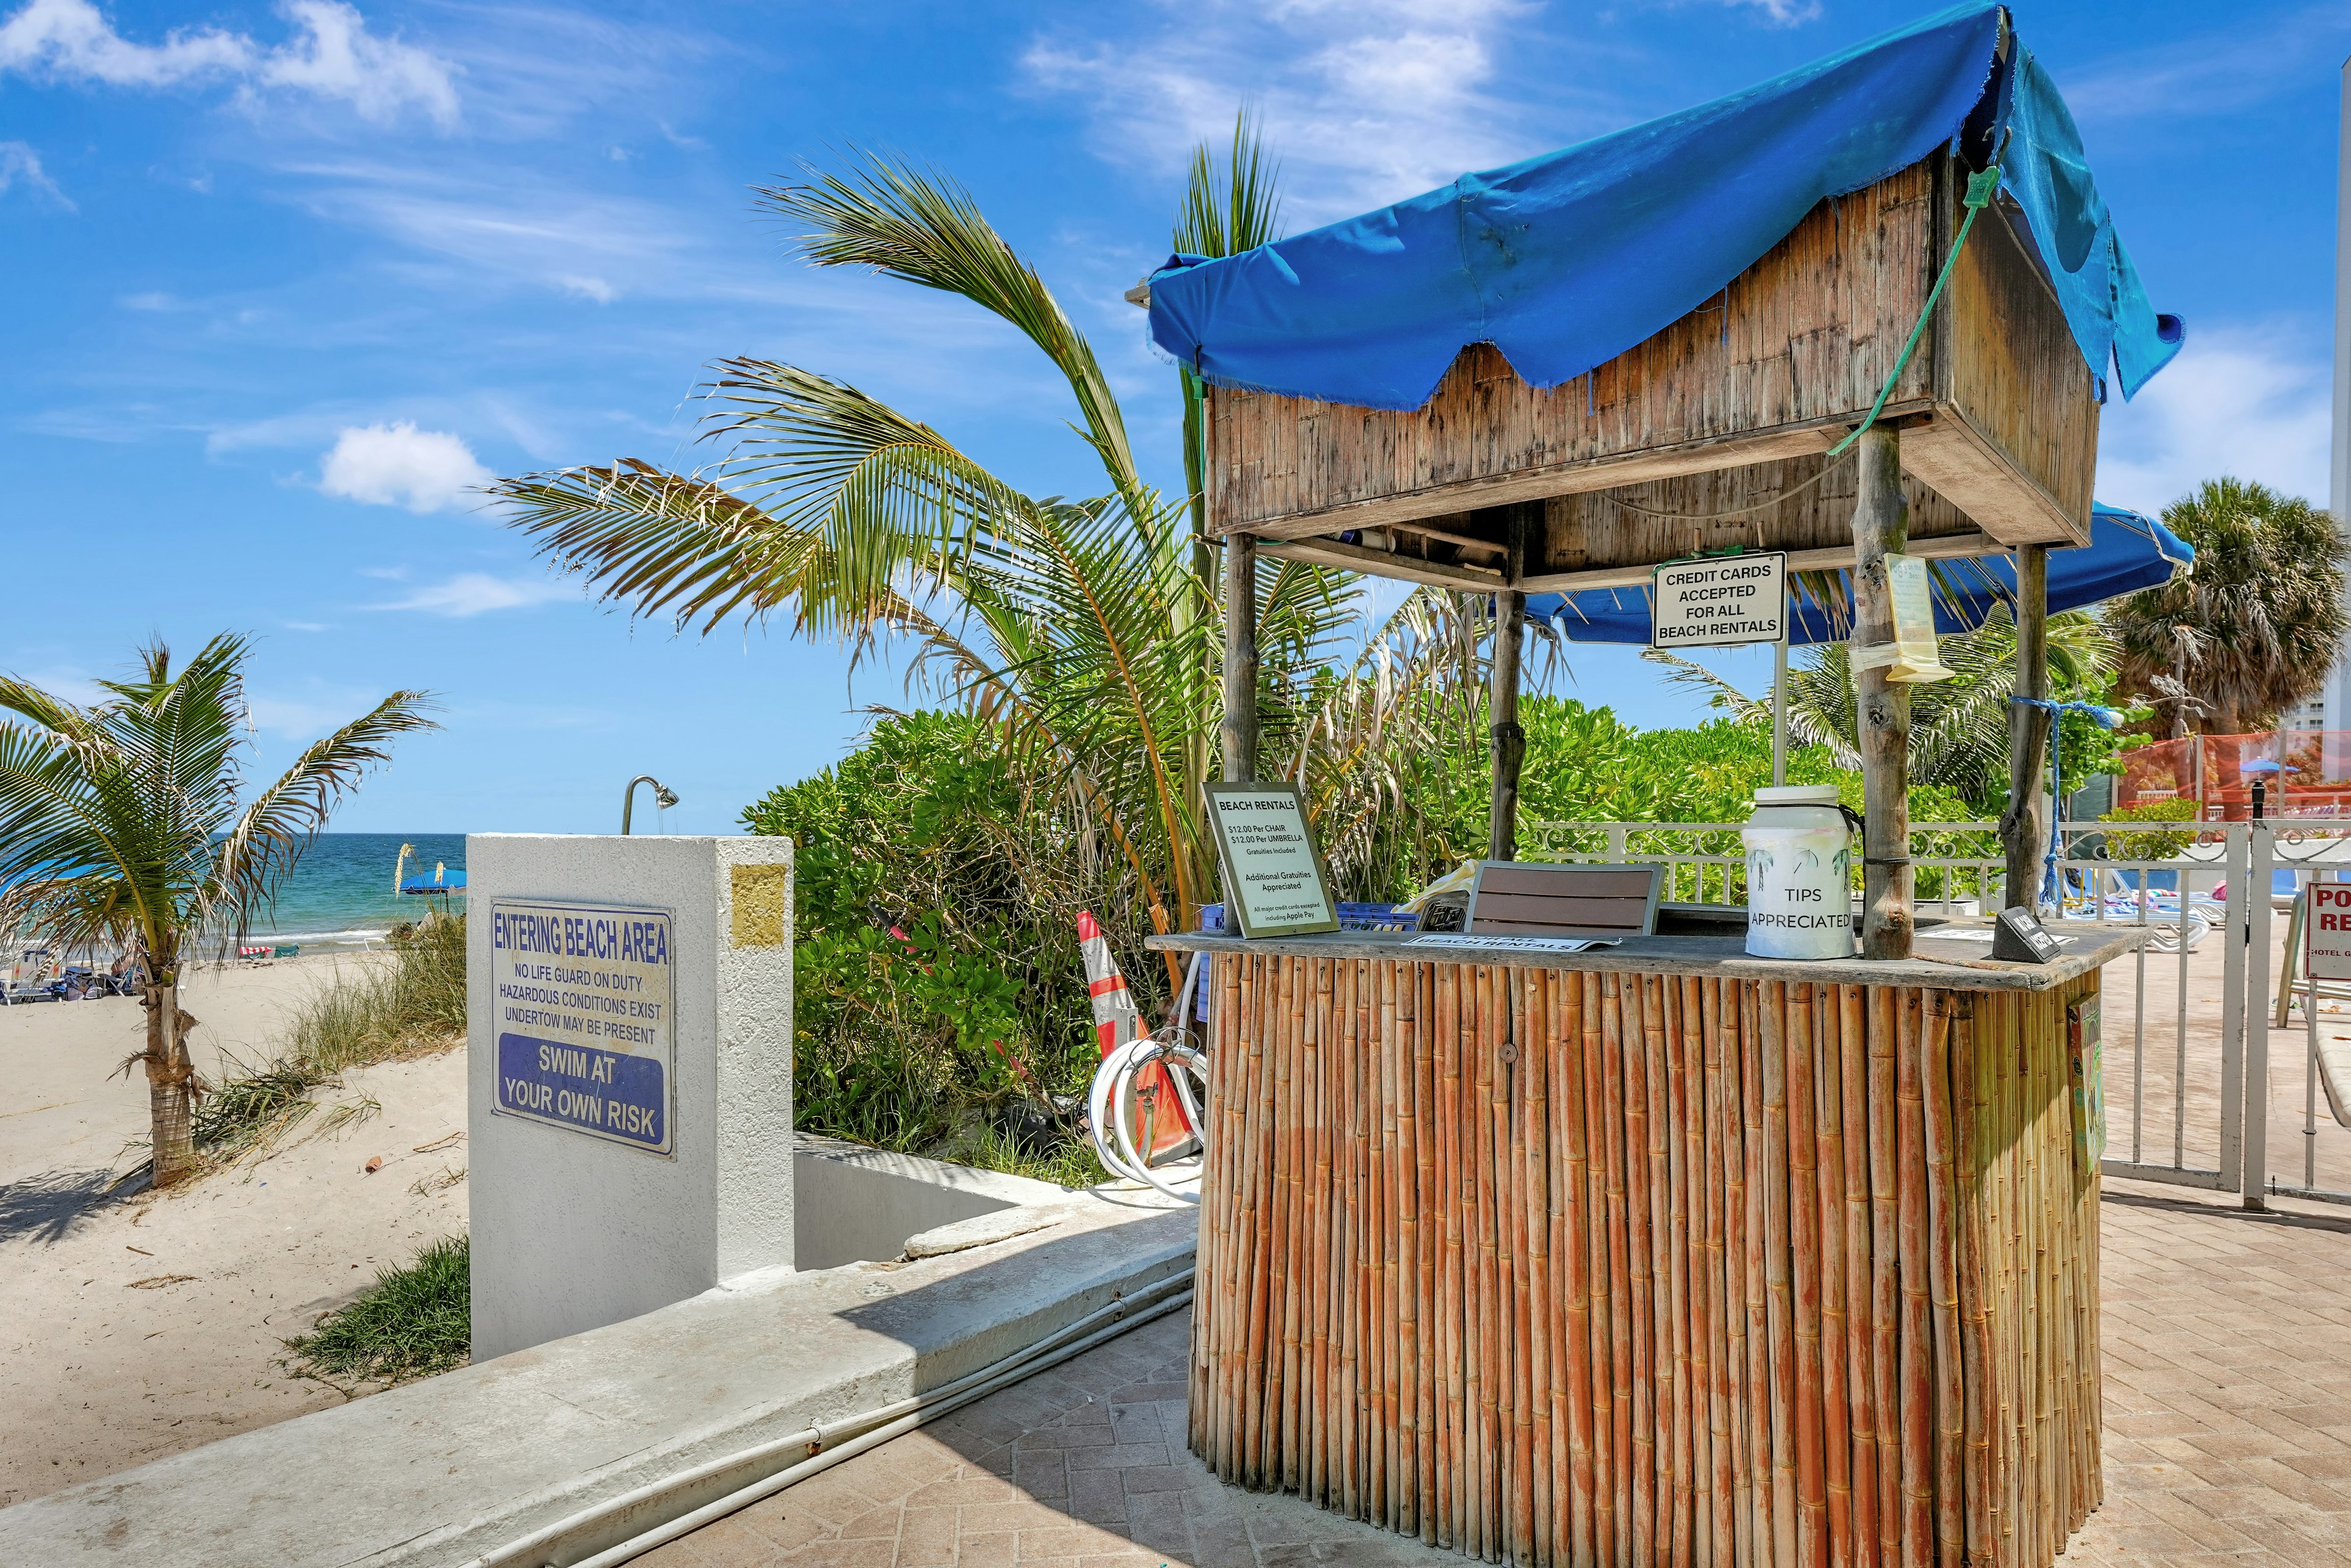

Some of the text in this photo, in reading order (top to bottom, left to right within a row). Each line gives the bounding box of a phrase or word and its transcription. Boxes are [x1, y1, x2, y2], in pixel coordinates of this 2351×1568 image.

[1666, 565, 1771, 585] CREDIT CARDS
[1679, 585, 1756, 602] ACCEPTED
[1686, 604, 1745, 619] FOR ALL
[1659, 619, 1777, 638] BEACH RENTALS
[1219, 801, 1295, 811] BEACH RENTALS
[1228, 825, 1252, 833] $12.00
[1232, 836, 1255, 844] $12.00
[1268, 834, 1303, 842] UMBRELLA
[1245, 871, 1311, 881] Additional Gratuities
[1262, 882, 1302, 892] Appreciated
[1785, 889, 1822, 902] TIPS
[2317, 890, 2351, 907] PO
[1286, 911, 1303, 920] Apple
[2321, 913, 2351, 931] RE
[495, 913, 667, 965] ENTERING BEACH AREA
[1483, 941, 1572, 950] RENTALS
[515, 963, 642, 992] NO LIFE GUARD ON DUTY
[500, 984, 661, 1020] HAZARDOUS CONDITIONS EXIST
[506, 1007, 655, 1044] UNDERTOW MAY BE PRESENT
[539, 1045, 615, 1084] SWIM AT
[505, 1077, 656, 1137] YOUR OWN RISK
